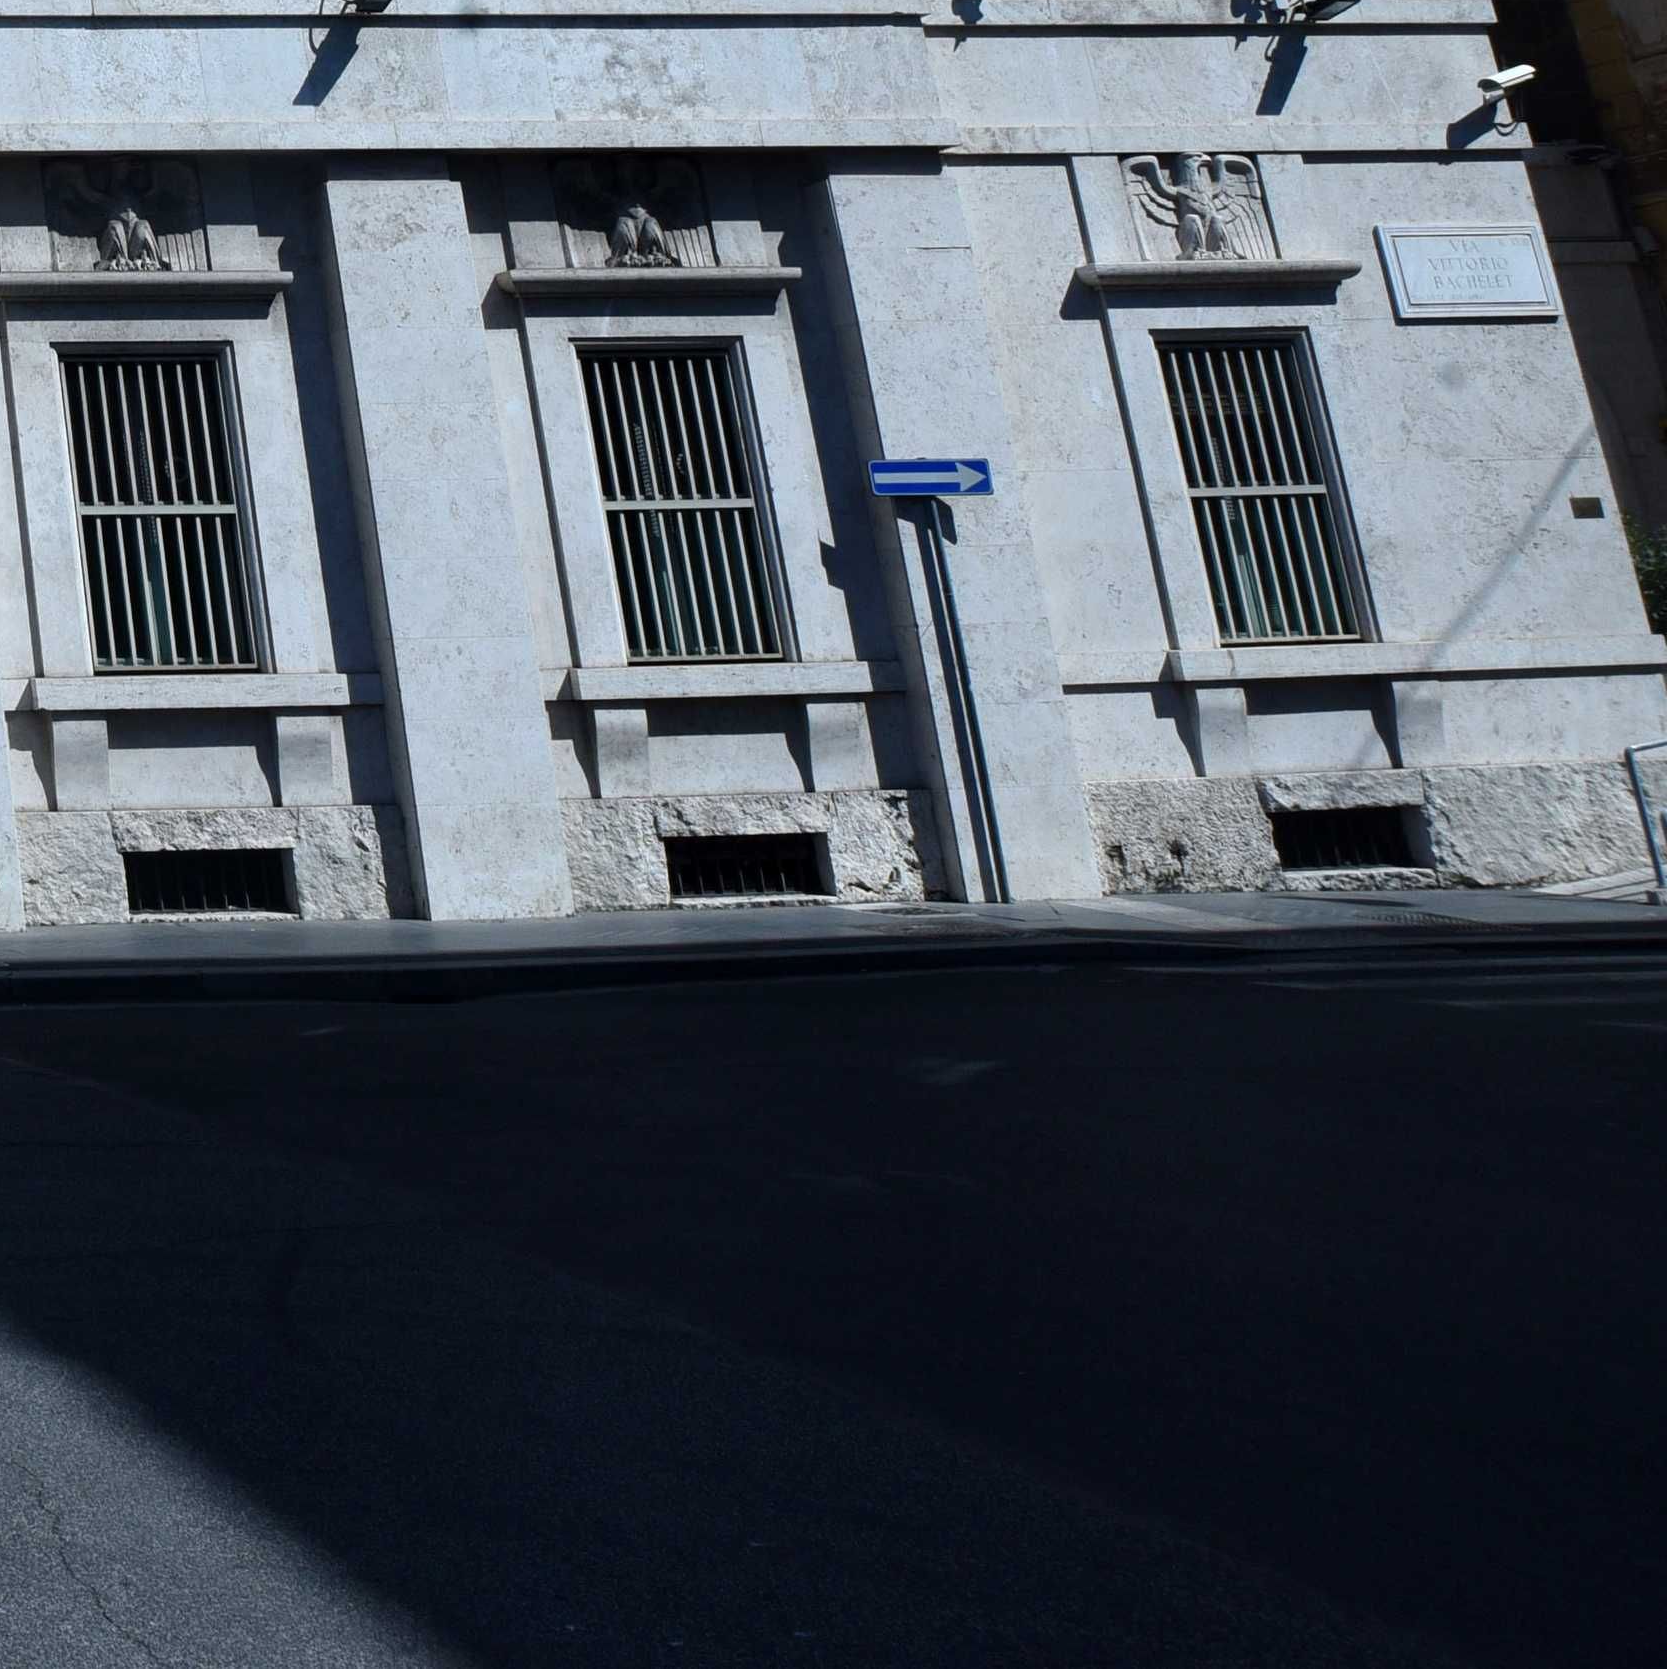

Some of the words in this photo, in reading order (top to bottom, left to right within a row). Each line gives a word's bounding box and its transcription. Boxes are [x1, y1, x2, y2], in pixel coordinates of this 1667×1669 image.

[1448, 238, 1481, 253] VIA
[1427, 257, 1509, 271] VITTORIO
[1433, 274, 1515, 290] BACHELET
